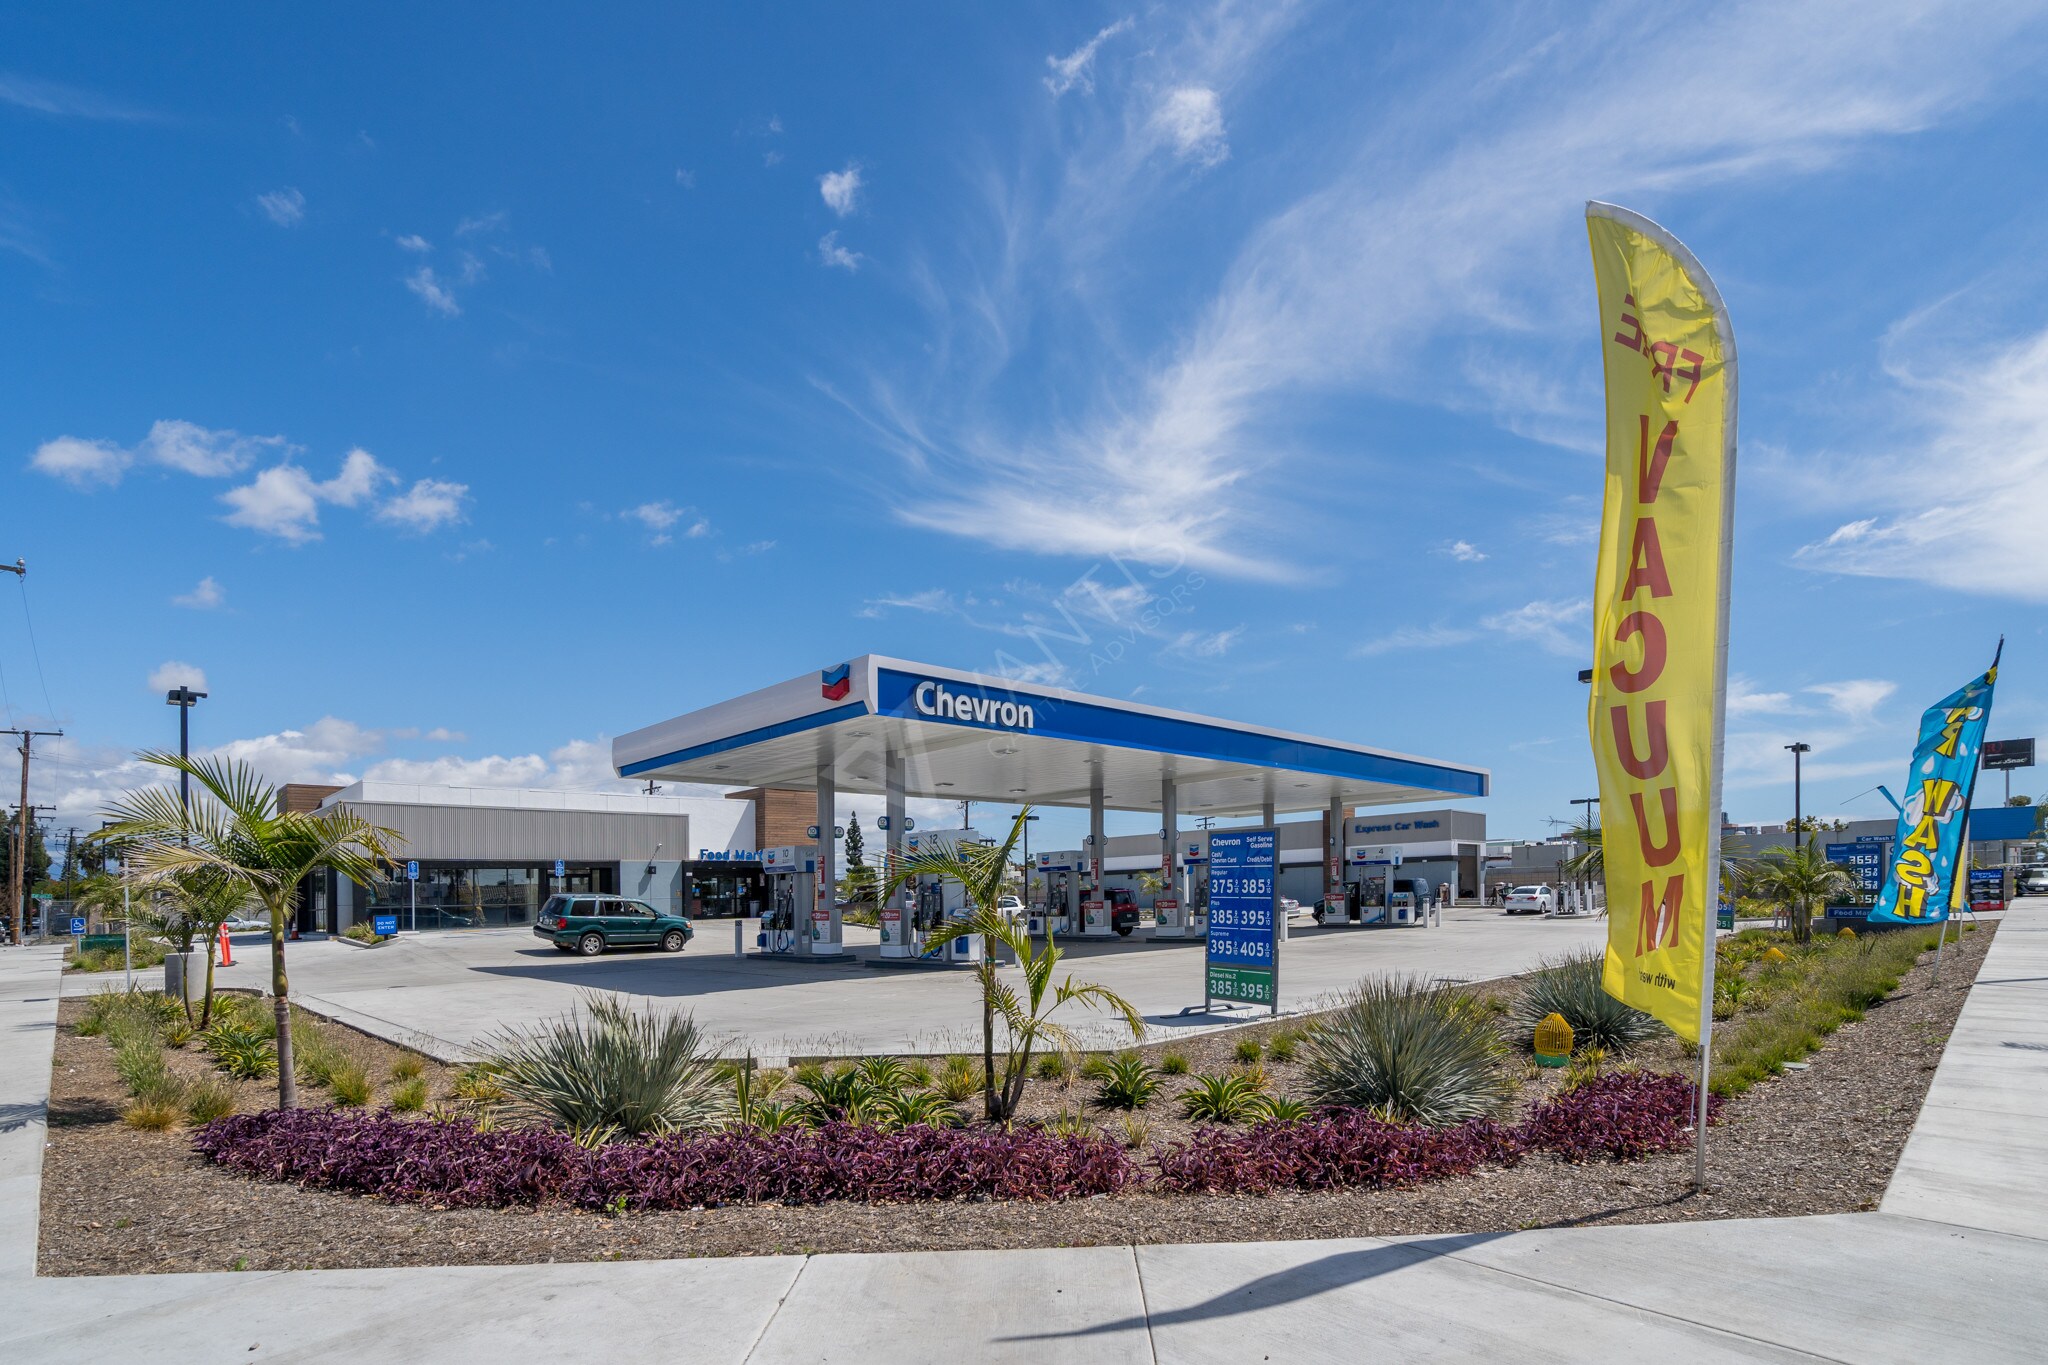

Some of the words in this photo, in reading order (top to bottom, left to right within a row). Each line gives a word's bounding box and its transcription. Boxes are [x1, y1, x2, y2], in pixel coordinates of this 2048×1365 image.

[915, 680, 1035, 729] Chevron
[1354, 824, 1392, 834] Express
[1394, 822, 1411, 830] Car
[1414, 820, 1440, 829] Wash
[929, 834, 938, 844] 12
[1212, 838, 1240, 846] Chevron
[700, 849, 730, 860] Food
[735, 849, 763, 860] Mart
[782, 849, 789, 858] 10
[1849, 855, 1872, 864] 365
[1212, 879, 1234, 894] 375
[1242, 879, 1265, 894] 385
[1212, 910, 1232, 924] 385
[1241, 910, 1265, 925] 395
[1211, 940, 1232, 954] 395
[1240, 942, 1264, 957] 405
[1211, 980, 1232, 995] 385
[1240, 982, 1263, 999] 395
